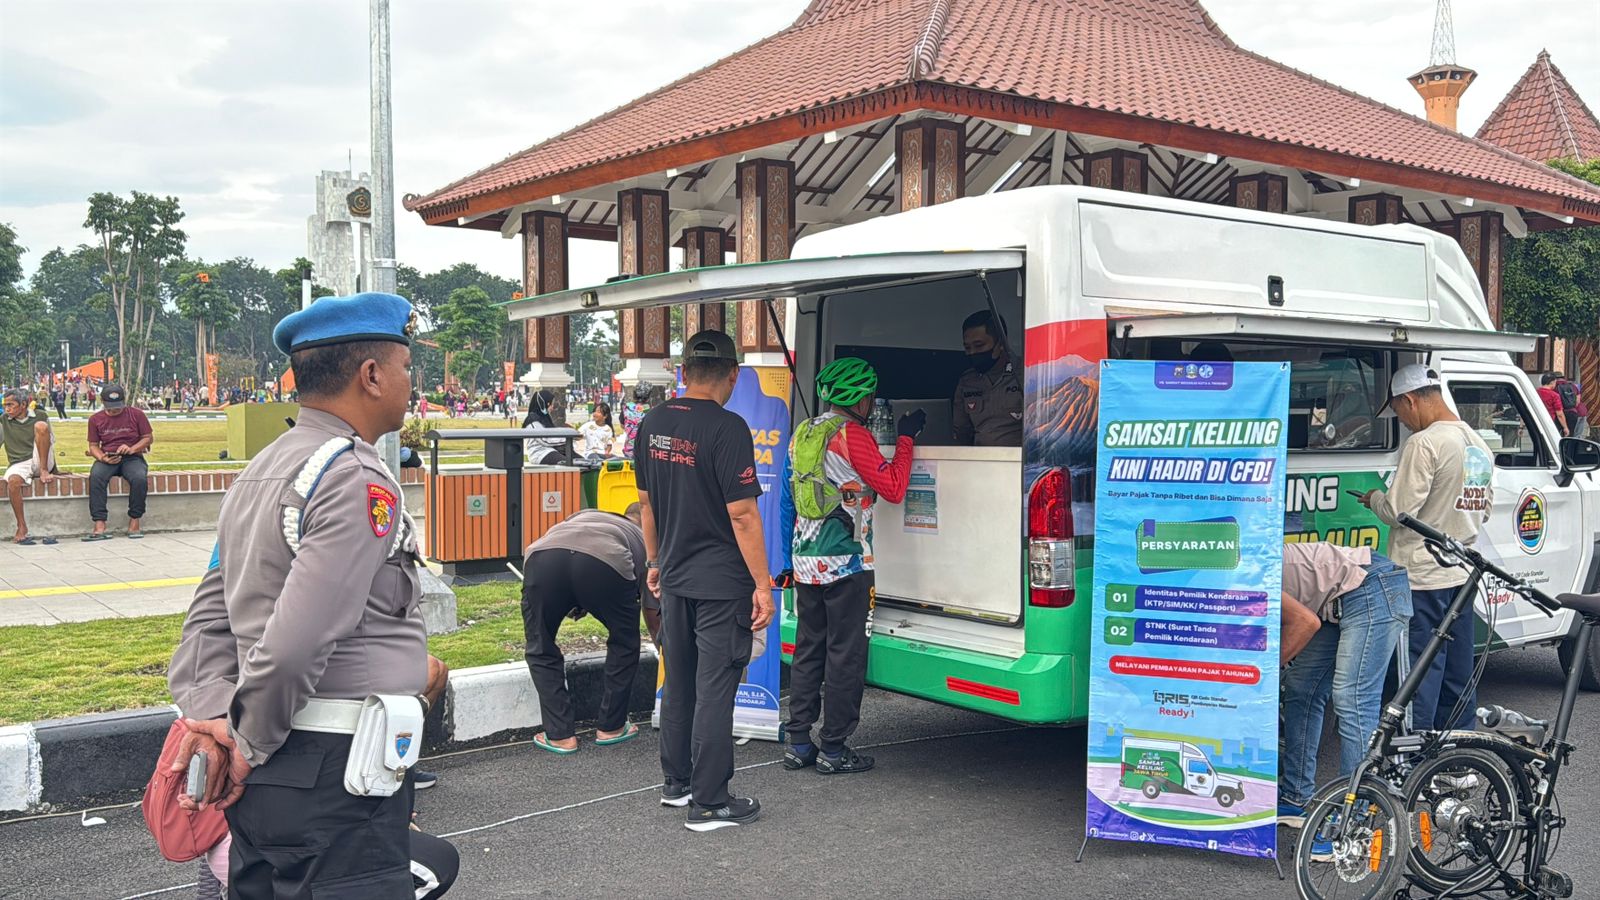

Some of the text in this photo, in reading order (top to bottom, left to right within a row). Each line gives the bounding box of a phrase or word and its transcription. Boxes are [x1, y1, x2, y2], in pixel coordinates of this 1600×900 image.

[1106, 421, 1279, 446] SAMSAT KELILING
[650, 449, 695, 466] THE GAME
[1110, 458, 1272, 482] KINI HADIR DI CFD!
[1141, 540, 1234, 550] PERSYARATAN
[1112, 588, 1249, 602] 01 Identitas Pemilik Kendaraan
[1144, 600, 1236, 612] (KTP/SIM/KK/ Passport)
[1110, 622, 1217, 636] 02 STNK (Surat Tanda
[1145, 633, 1218, 645] Pemilik Kendaraan)
[1115, 662, 1254, 678] MELAYANI PEMBAYARAN PAJAK TAHUNAN
[1160, 707, 1189, 719] Ready
